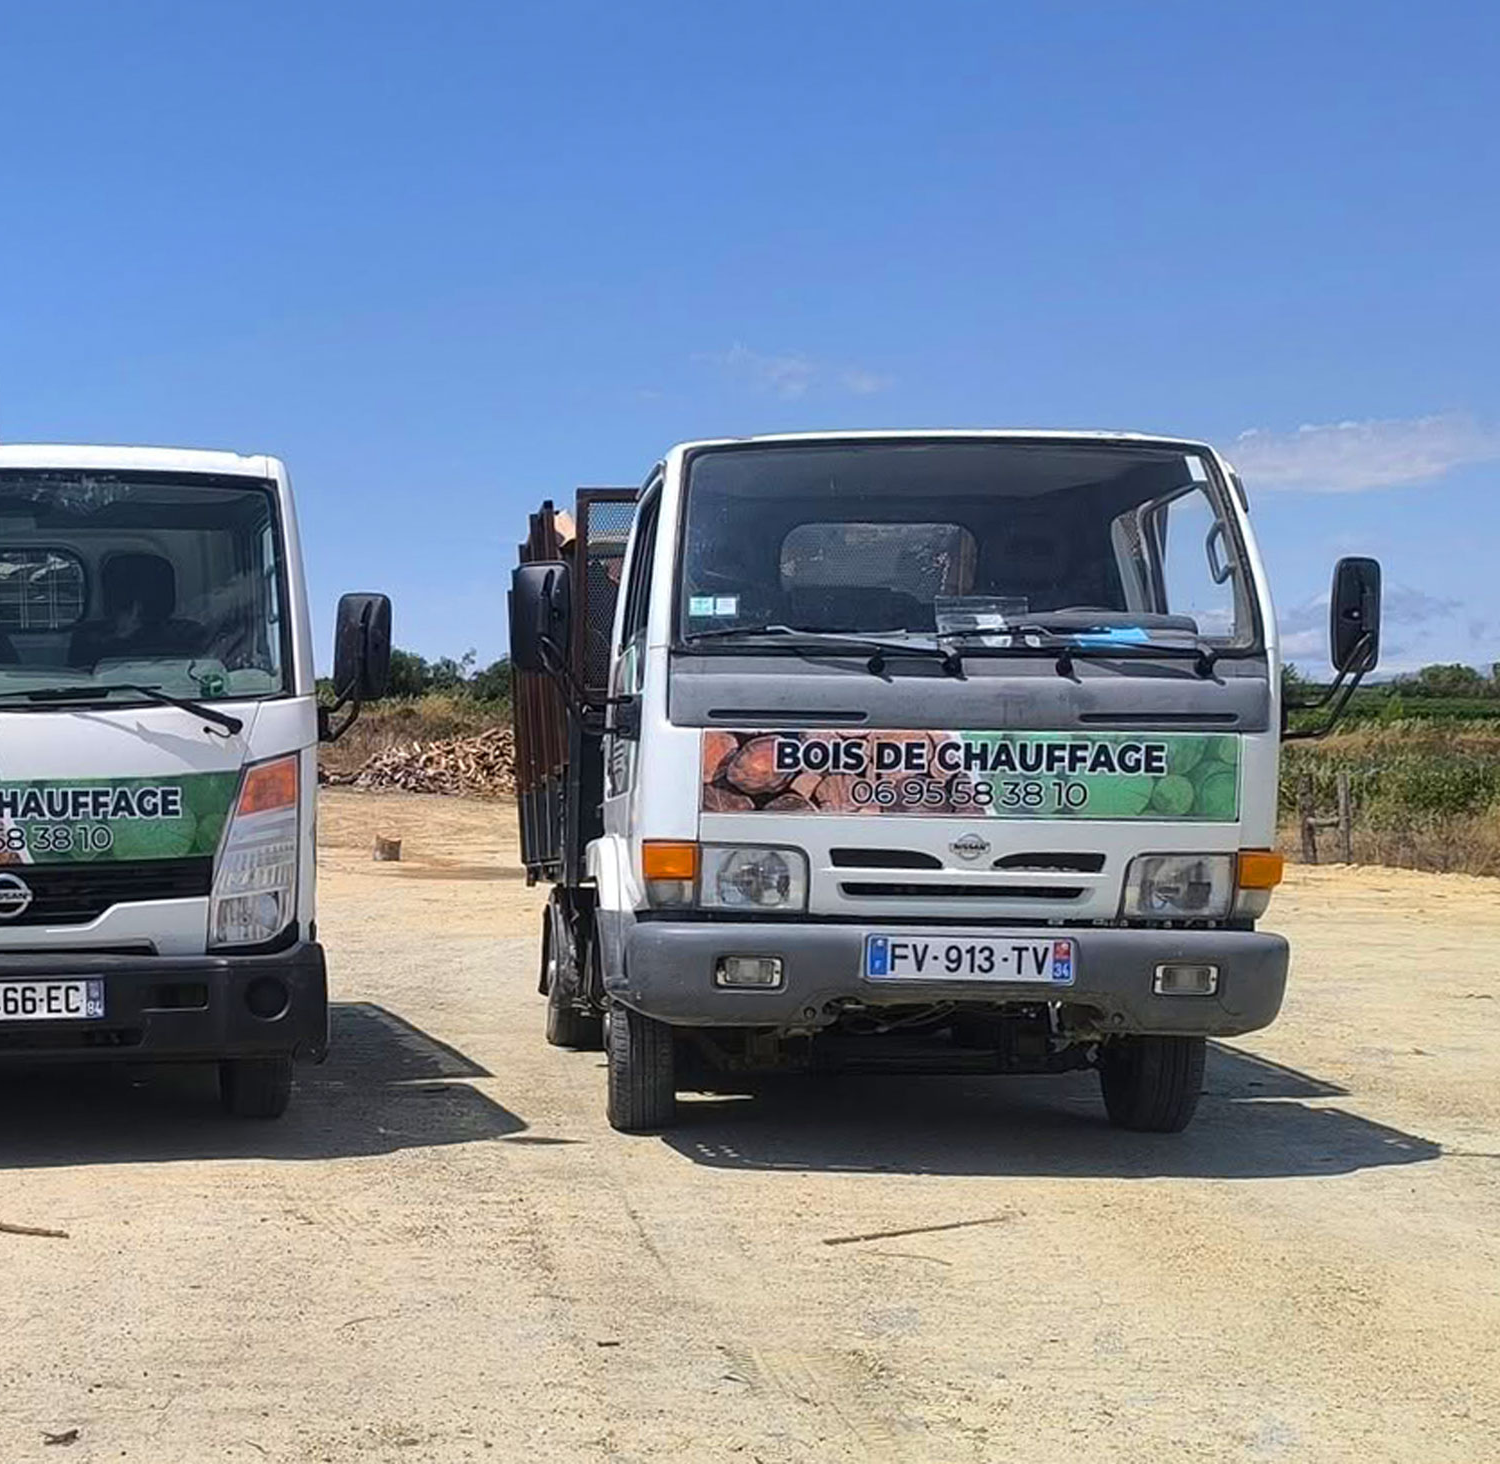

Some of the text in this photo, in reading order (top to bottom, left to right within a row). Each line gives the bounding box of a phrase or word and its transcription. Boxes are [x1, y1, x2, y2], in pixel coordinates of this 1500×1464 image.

[776, 739, 1167, 775] BOIS DE CHAUFFAGE
[851, 780, 1088, 809] 06 95 58 38 10
[32, 825, 74, 851] 38
[78, 825, 113, 851] 10
[890, 943, 1049, 976] FV-913-TV
[1053, 962, 1070, 978] 34
[87, 1000, 103, 1015] 84
